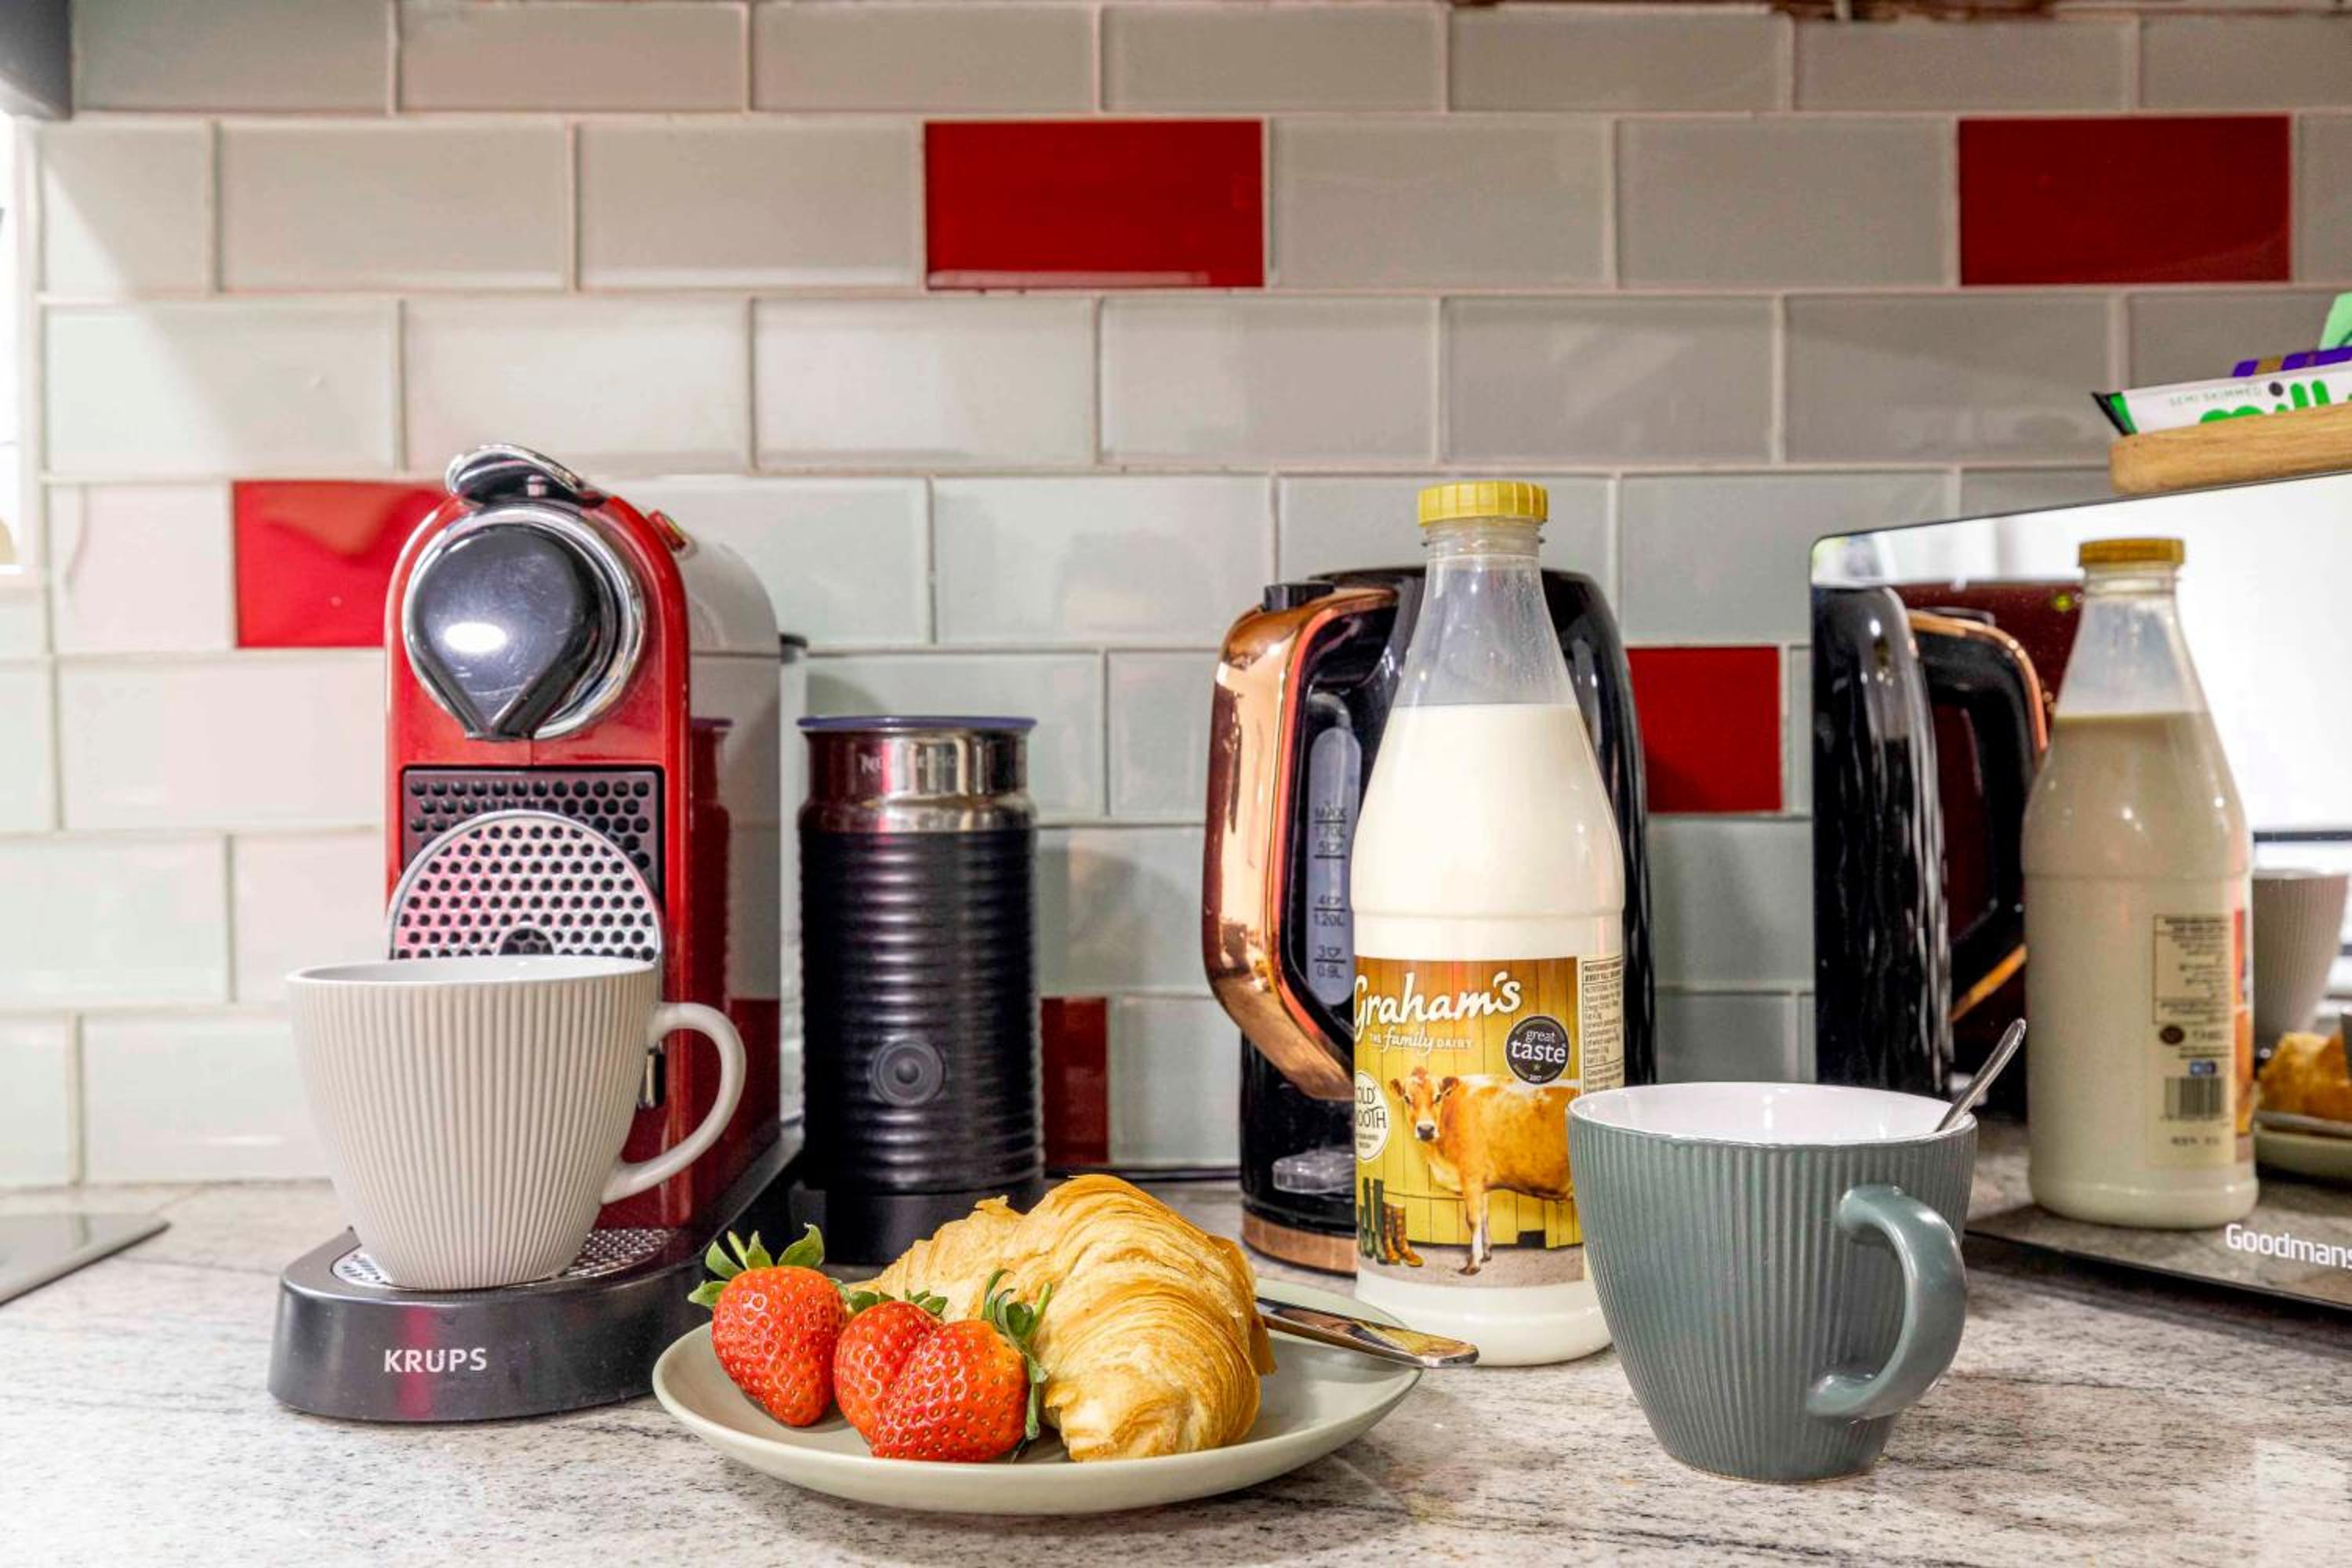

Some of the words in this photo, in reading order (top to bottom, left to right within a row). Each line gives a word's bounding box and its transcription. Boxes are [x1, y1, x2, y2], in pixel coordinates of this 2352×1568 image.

[1355, 971, 1522, 1043] Graham's
[1380, 1025, 1434, 1057] family
[1436, 1038, 1472, 1049] DAIRY
[1525, 1029, 1556, 1044] great
[1510, 1040, 1566, 1065] taste
[1355, 1105, 1387, 1129] OOTH
[383, 1347, 488, 1374] KRUPS
